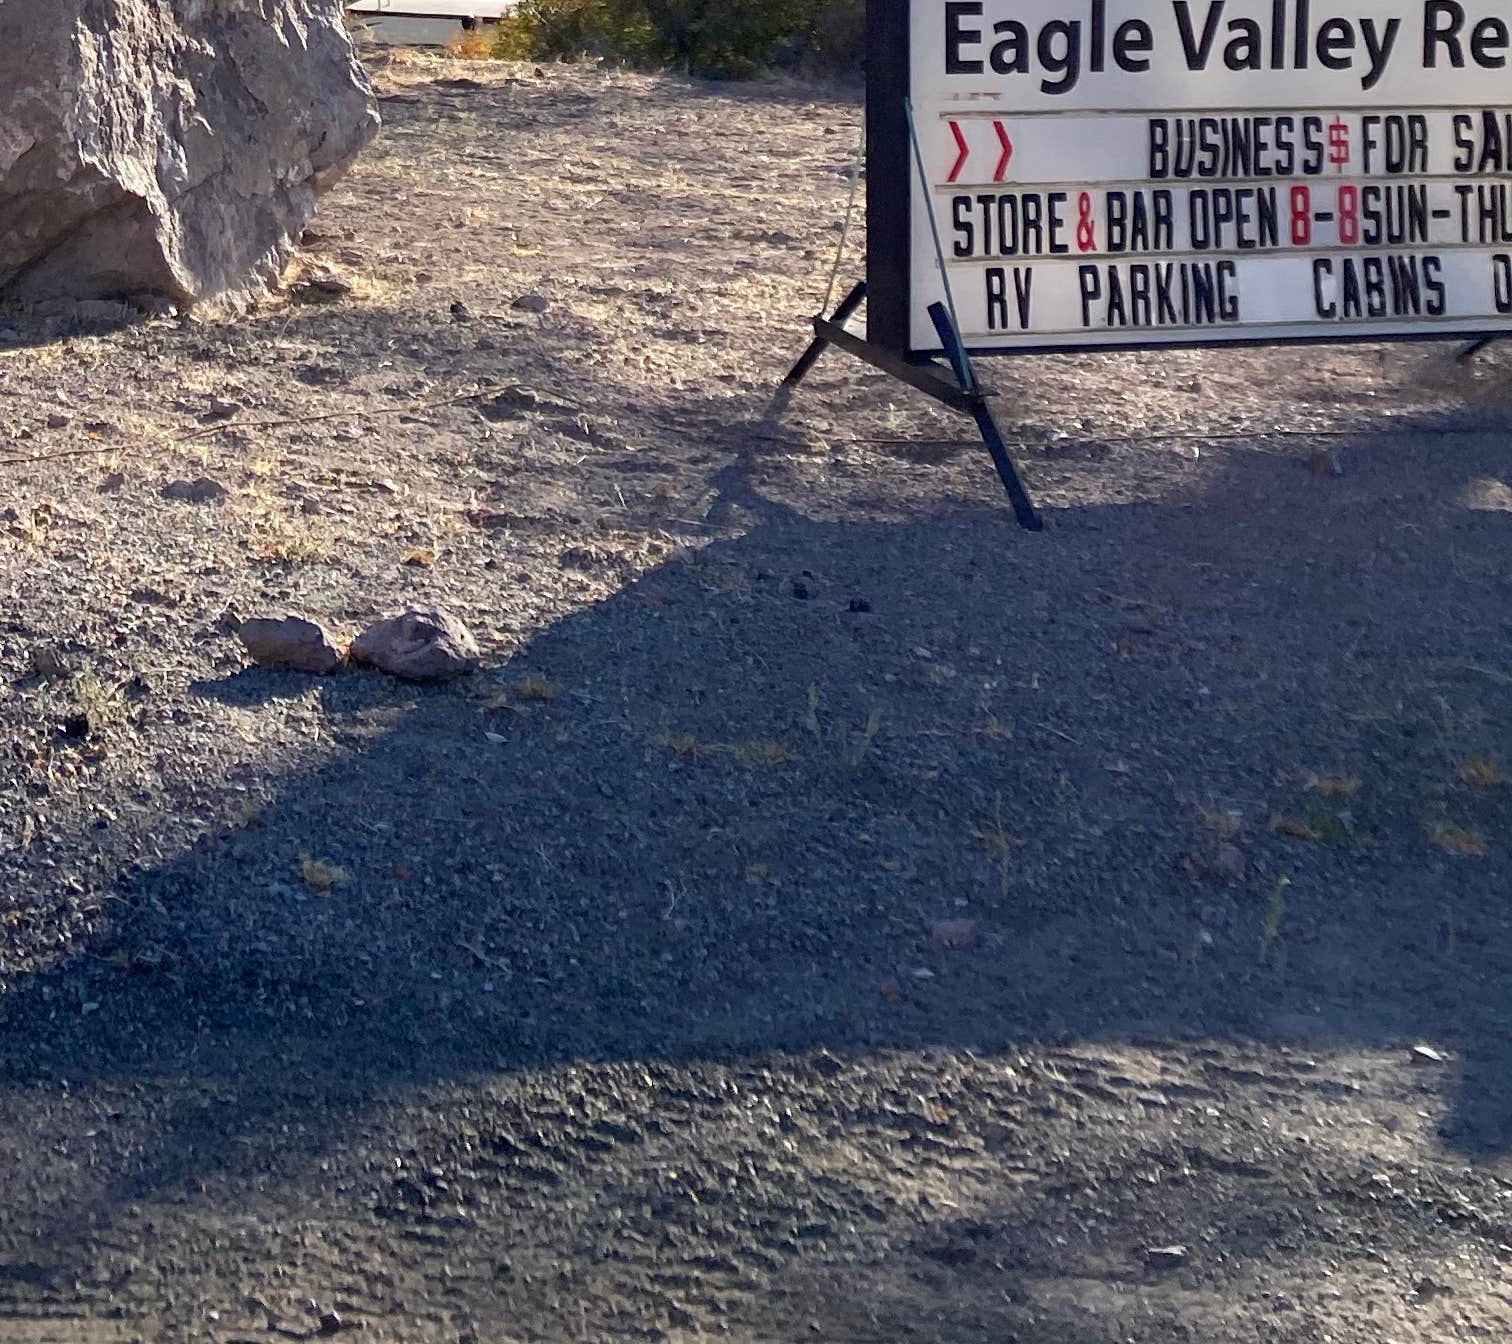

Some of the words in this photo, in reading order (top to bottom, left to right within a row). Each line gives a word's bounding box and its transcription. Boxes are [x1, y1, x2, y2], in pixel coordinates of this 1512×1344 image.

[1362, 114, 1428, 175] FOR
[952, 192, 1069, 258] STORE
[1106, 190, 1174, 253] BAR
[1189, 187, 1279, 250] OPEN
[985, 266, 1034, 330] RV
[1077, 259, 1240, 327] PARKING
[1312, 254, 1447, 321] CABINS
